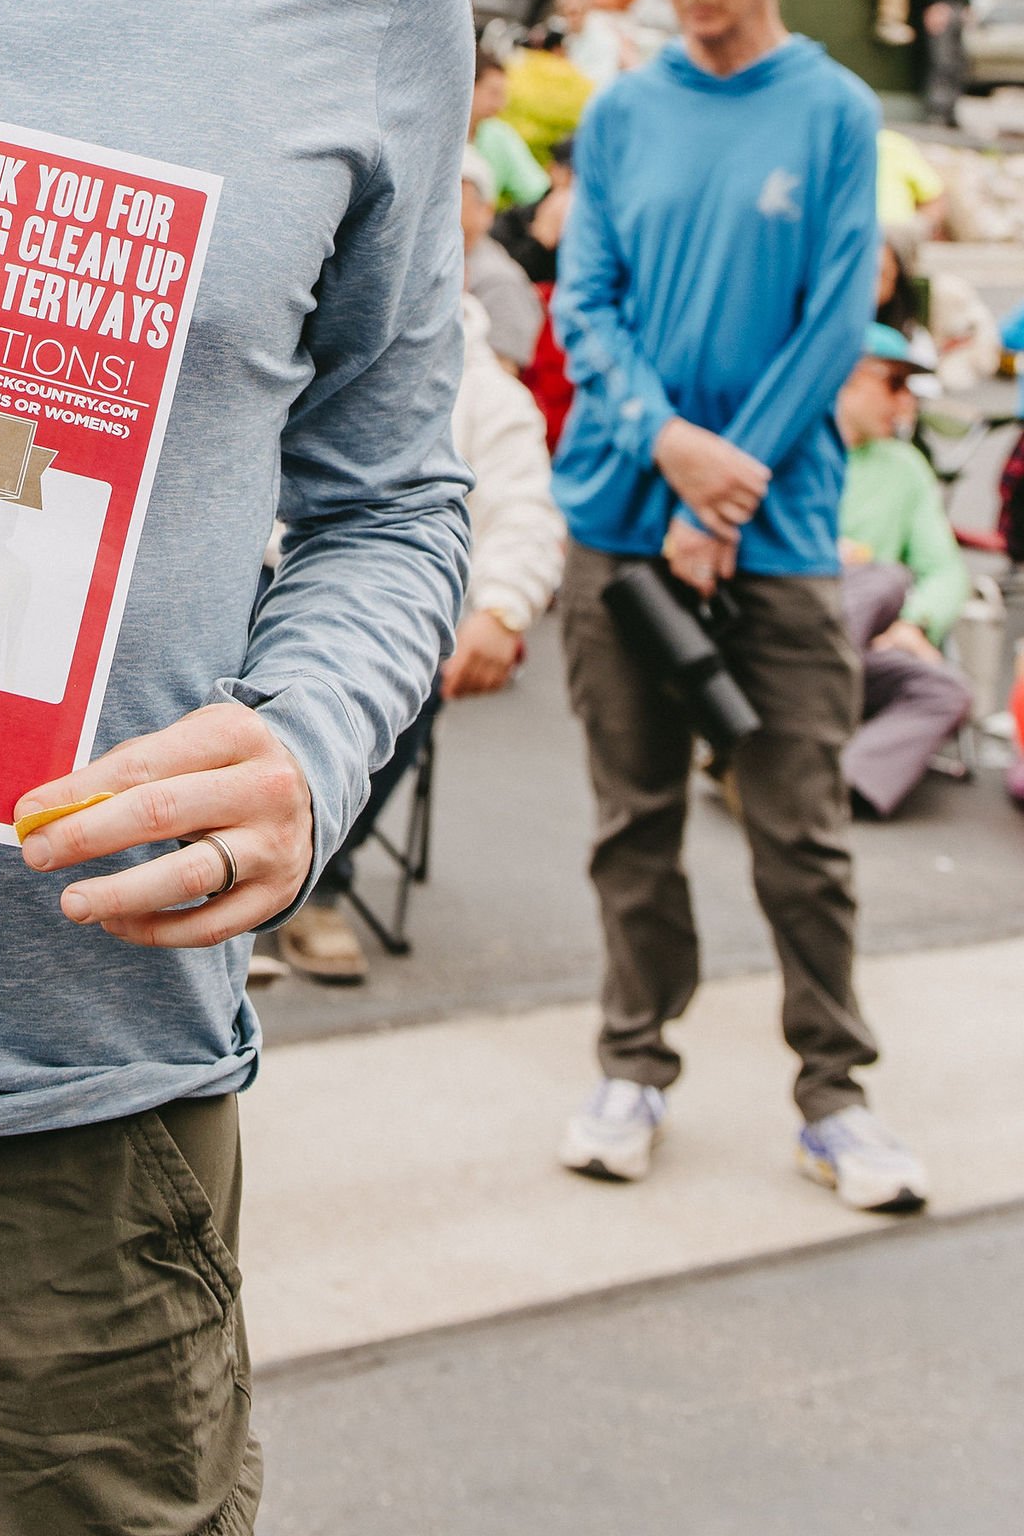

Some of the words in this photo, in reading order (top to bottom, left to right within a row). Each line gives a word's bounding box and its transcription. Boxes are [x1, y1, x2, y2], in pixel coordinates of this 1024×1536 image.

[34, 163, 105, 223] YOU
[105, 183, 176, 244] FOR
[17, 214, 133, 286] CLEAN
[135, 243, 186, 297] UP
[13, 397, 42, 416] OR
[43, 404, 131, 440] WOMENS)
